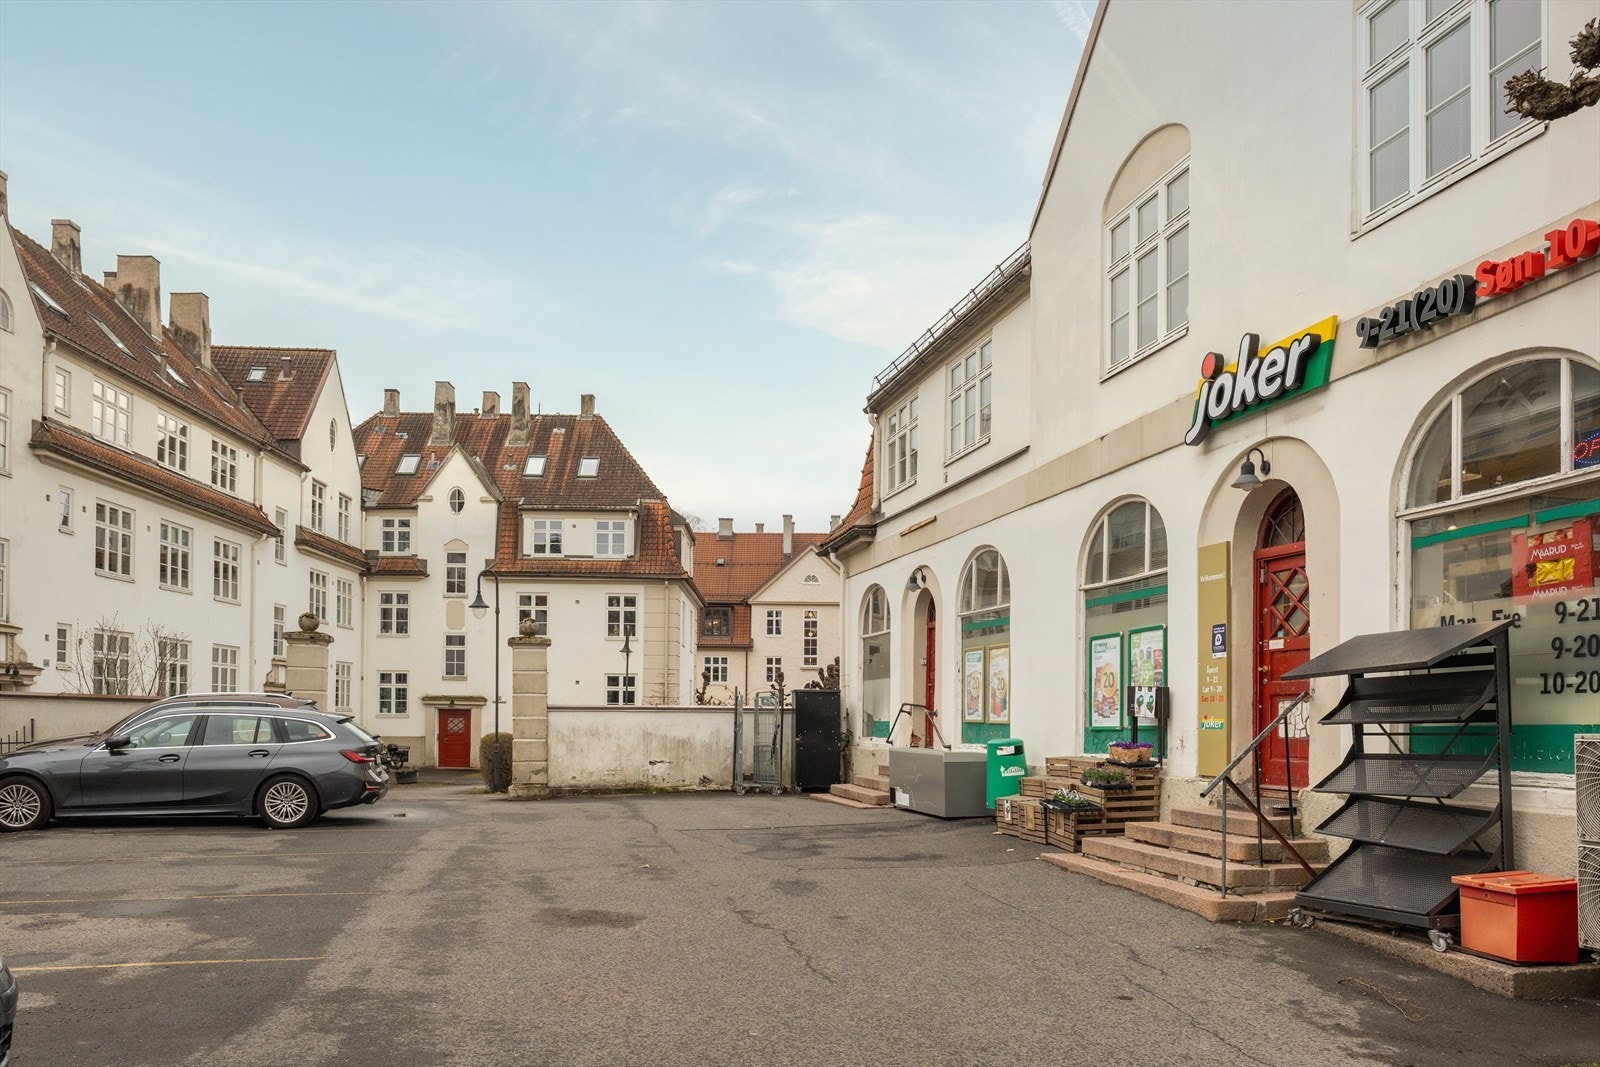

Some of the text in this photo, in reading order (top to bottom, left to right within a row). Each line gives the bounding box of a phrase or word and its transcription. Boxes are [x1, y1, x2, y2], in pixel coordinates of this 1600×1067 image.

[1356, 274, 1476, 349] 9-21(20)
[1475, 251, 1545, 297] Søn
[1185, 332, 1321, 446] joker
[1530, 544, 1567, 561] MAARUD
[1530, 586, 1568, 601] MAARUD
[1492, 609, 1521, 629] Fe
[1555, 598, 1600, 624] 9-21
[1551, 634, 1600, 660] 9-20
[972, 677, 979, 690] 20
[997, 677, 1005, 691] 20
[1102, 671, 1115, 689] 20
[1540, 670, 1600, 695] 10-20
[1201, 714, 1224, 731] joker
